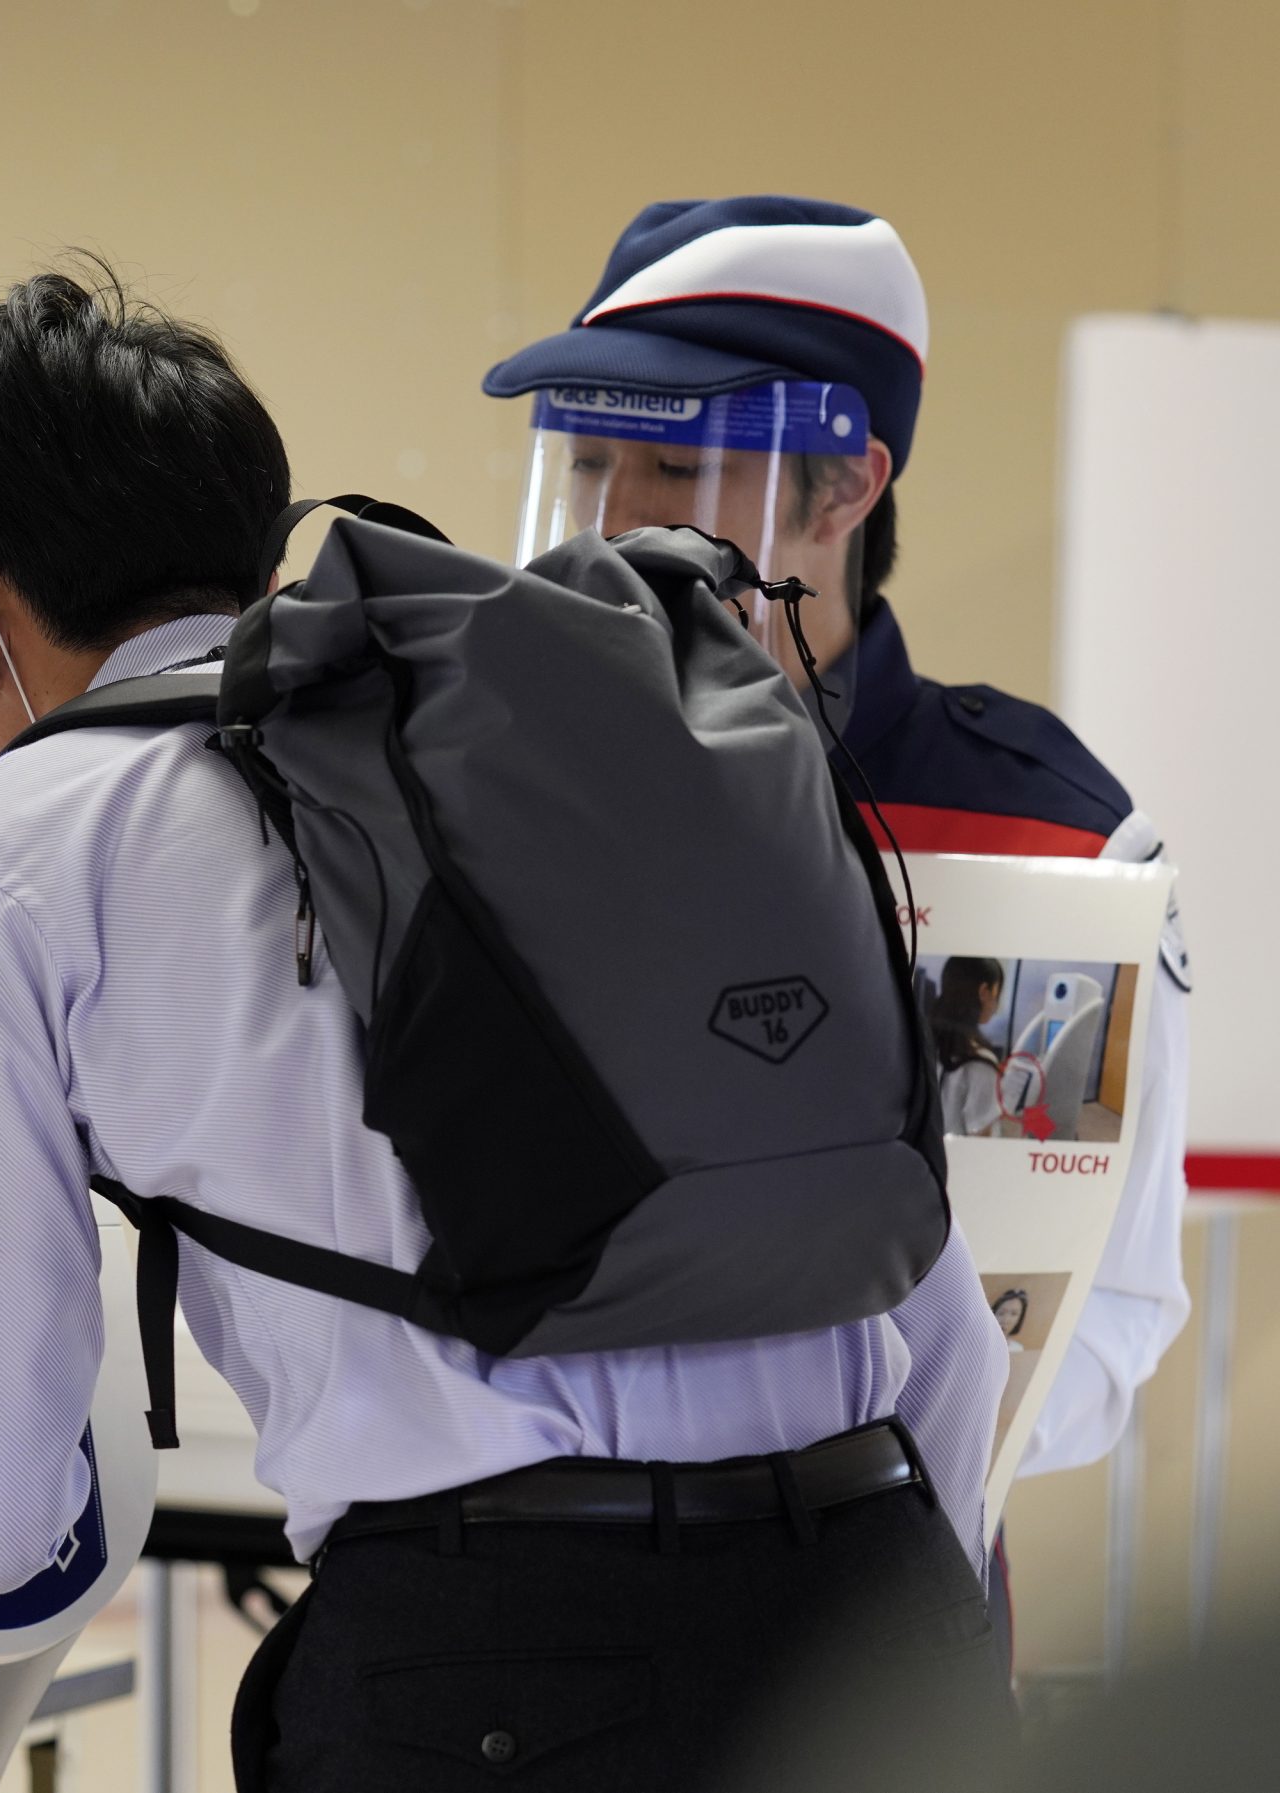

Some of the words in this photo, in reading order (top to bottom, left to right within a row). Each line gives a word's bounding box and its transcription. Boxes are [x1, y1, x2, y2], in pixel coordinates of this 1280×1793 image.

[604, 389, 685, 415] Shield
[727, 987, 804, 1020] BUDDY
[762, 1017, 788, 1045] 16
[1027, 1152, 1110, 1176] TOUCH
